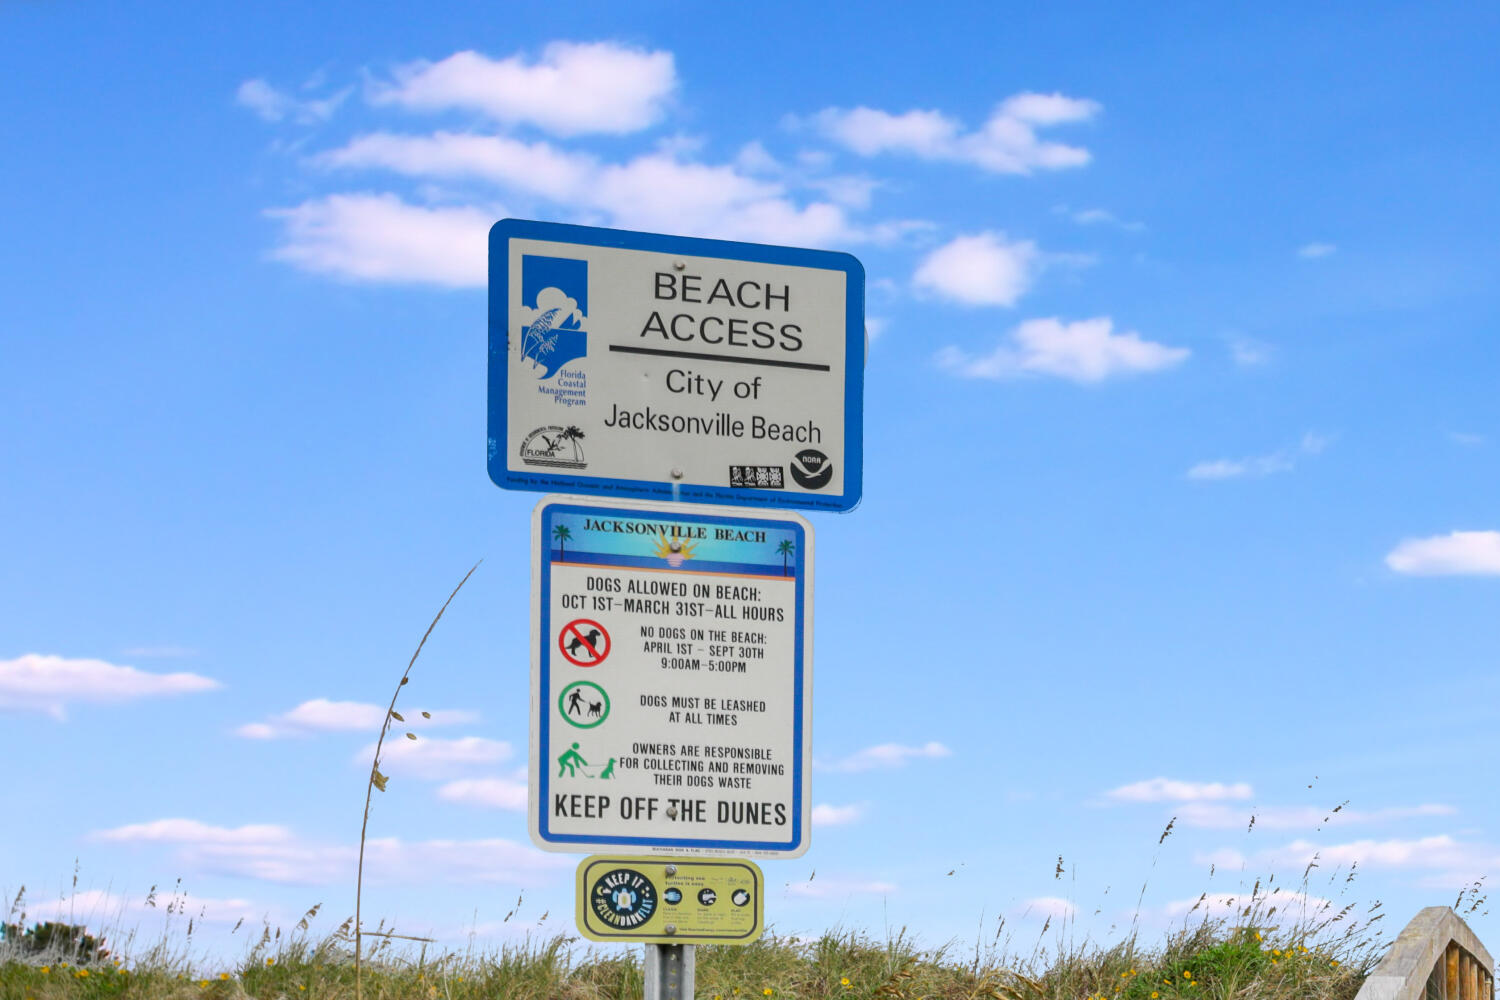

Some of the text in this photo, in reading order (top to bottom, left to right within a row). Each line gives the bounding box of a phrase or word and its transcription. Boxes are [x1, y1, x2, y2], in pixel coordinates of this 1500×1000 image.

[653, 272, 790, 312] BEACH
[640, 311, 804, 352] ACCESS
[557, 378, 586, 388] Coastal
[560, 369, 586, 379] Florida
[538, 386, 586, 398] Management
[665, 369, 762, 401] City of
[555, 396, 586, 407] Program
[604, 404, 821, 444] Jacksonville Beach
[583, 518, 766, 543] JACKSONVILLE BEACH
[587, 576, 761, 601] DOGS ALLOWED ON BEACH:
[561, 593, 587, 609] OCT
[742, 606, 784, 622] HOURS
[640, 626, 767, 645] NO DOGS ON THE BEACH:
[643, 641, 673, 654] APRIL
[676, 642, 693, 655] 1ST
[709, 645, 734, 658] SEPT
[738, 646, 764, 659] 30TH
[640, 694, 766, 713] DOGS MUST BE LEASHED
[669, 711, 738, 726] AT ALL TIMES
[632, 742, 772, 760] OWNERS ARE RESPONSIBLE
[619, 757, 785, 776] FOR COLLECTING AND REMOVING
[653, 773, 752, 789] THEIR DOGS WASTE
[555, 793, 787, 826] KEEP OFF THE DUNES
[605, 873, 645, 888] KEEP IT
